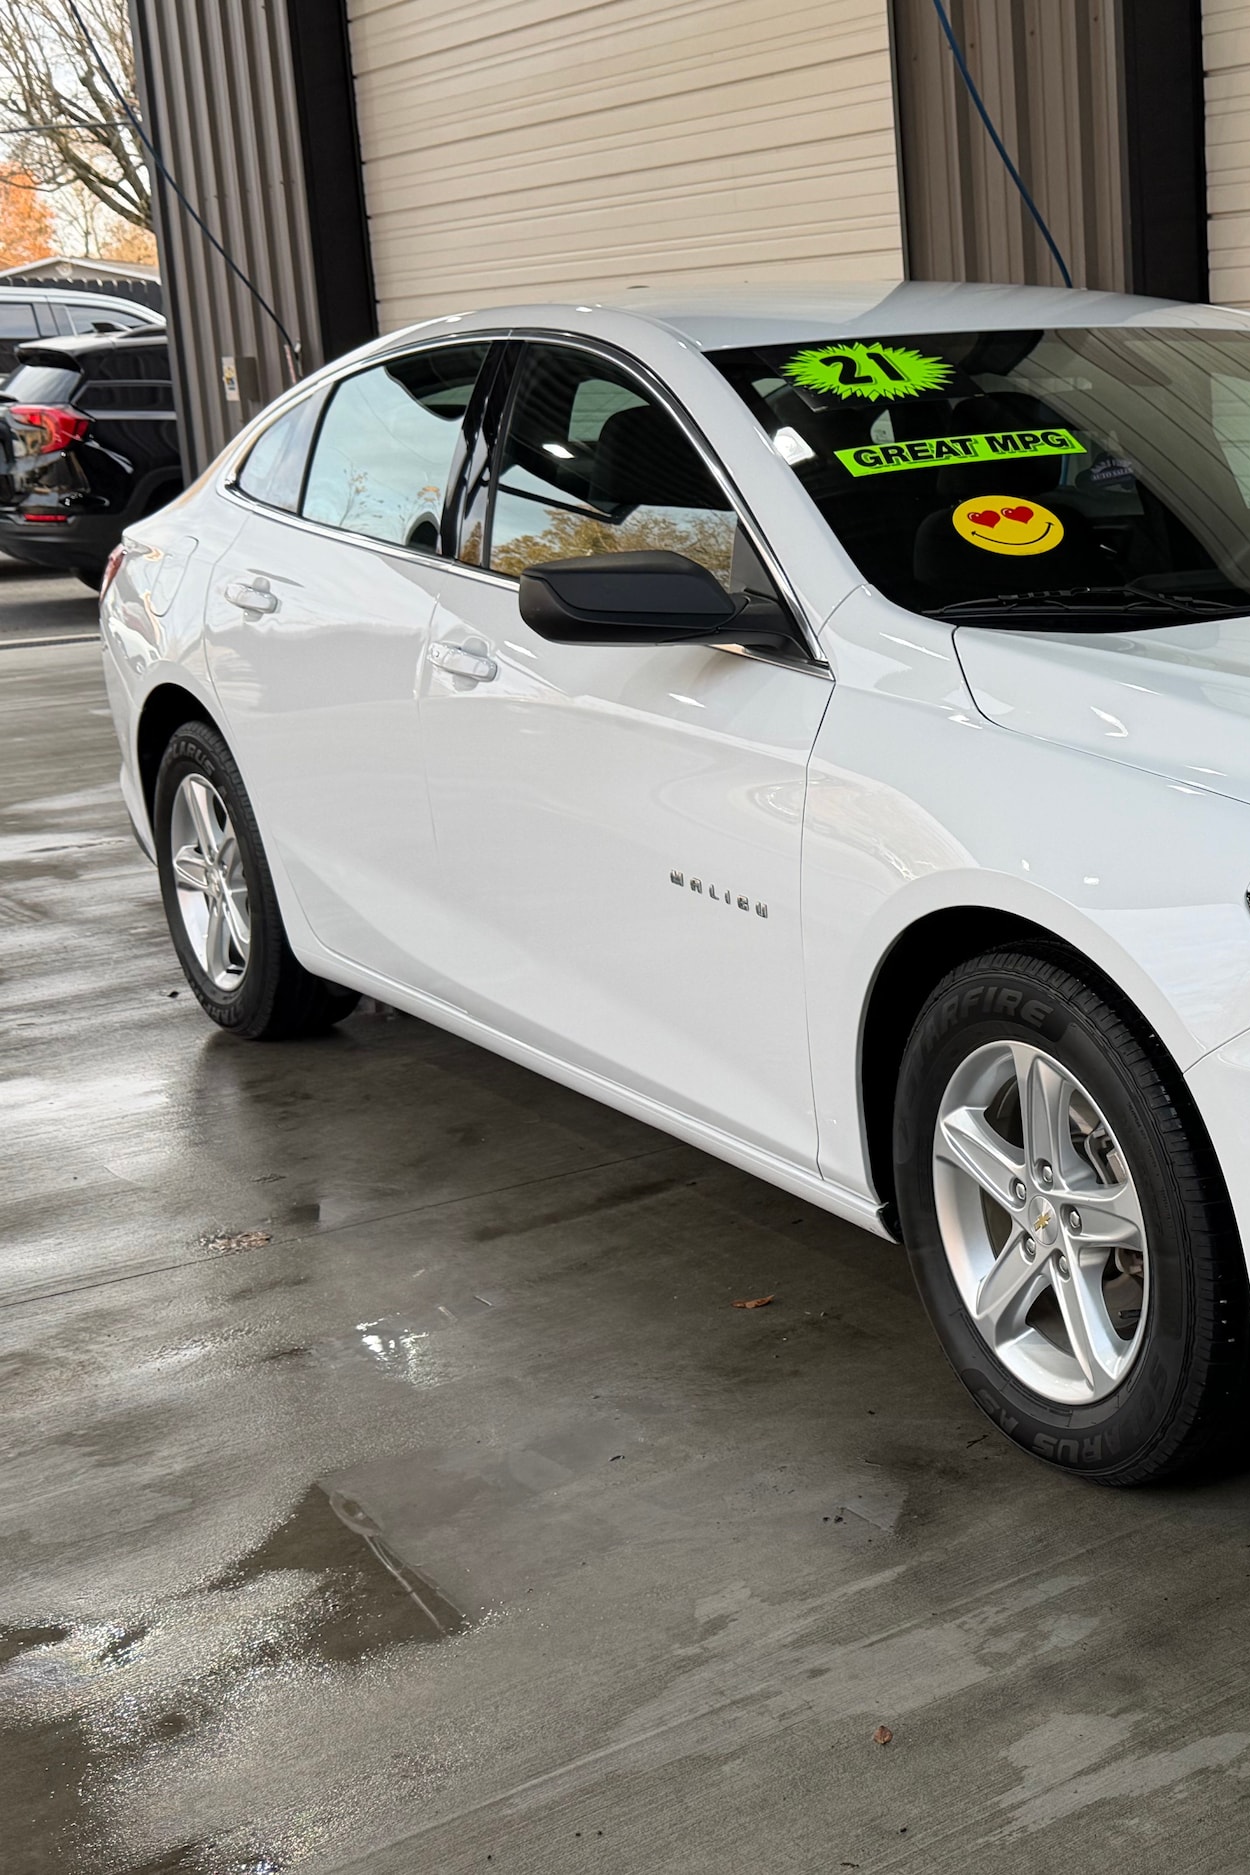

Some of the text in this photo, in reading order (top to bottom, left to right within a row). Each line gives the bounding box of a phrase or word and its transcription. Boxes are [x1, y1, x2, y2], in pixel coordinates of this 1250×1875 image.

[819, 352, 908, 387] 21
[852, 430, 1072, 469] GREAT MPG
[669, 868, 769, 919] MALIBU
[917, 985, 1056, 1064] ARFIRE
